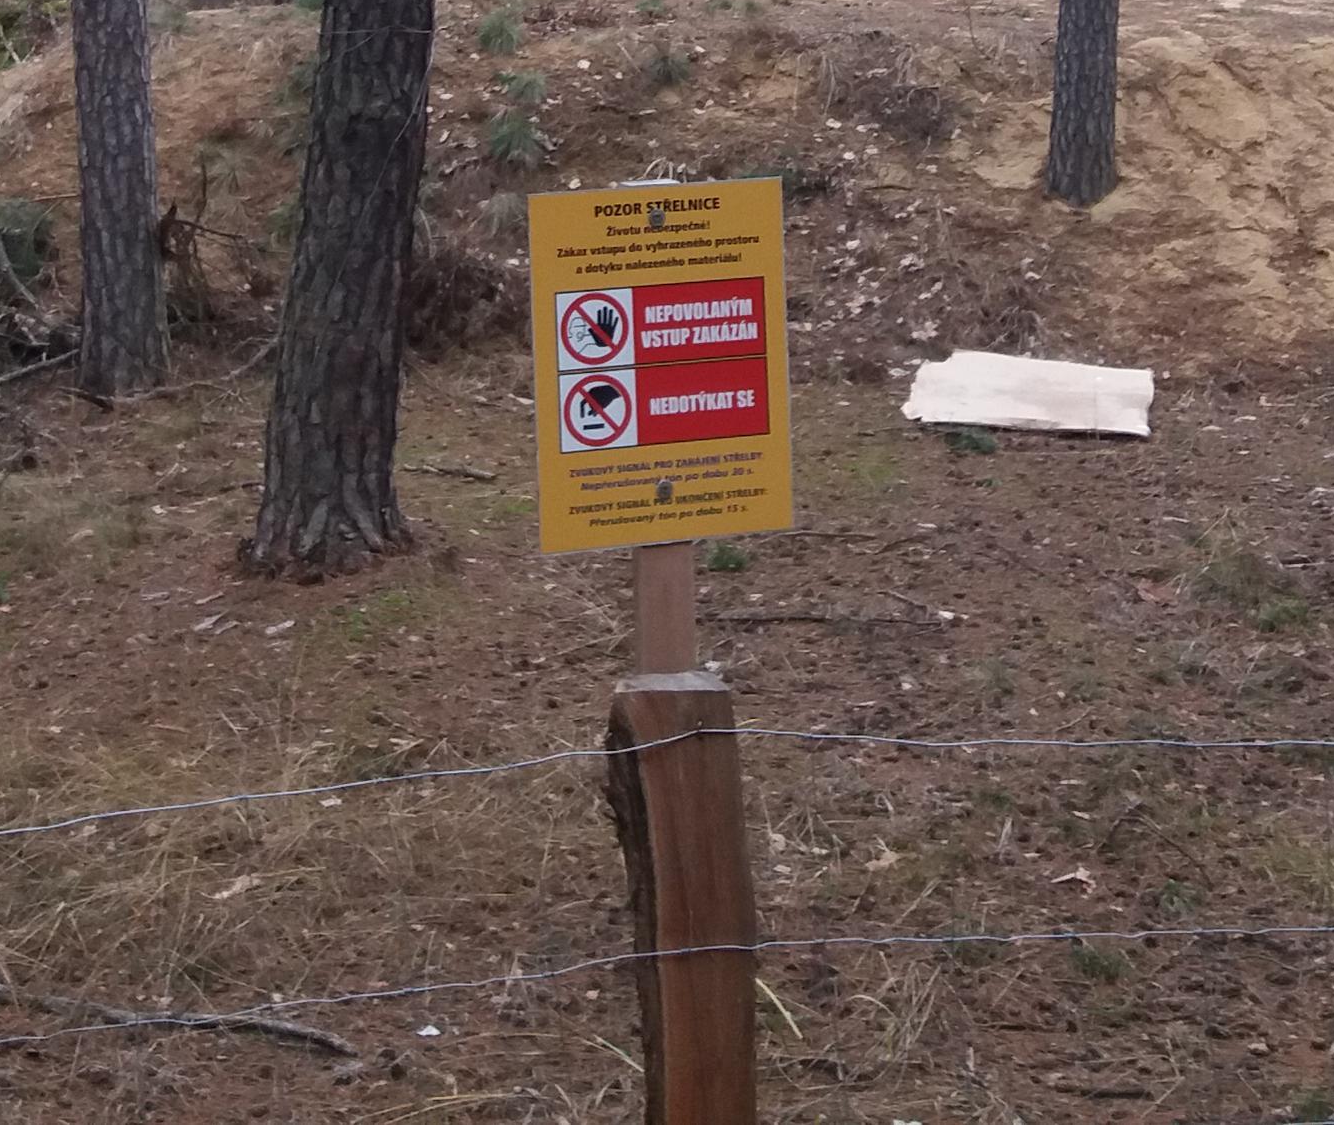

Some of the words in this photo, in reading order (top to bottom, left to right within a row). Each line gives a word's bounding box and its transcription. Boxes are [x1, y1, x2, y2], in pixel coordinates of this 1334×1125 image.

[594, 202, 642, 217] POZOR
[646, 197, 721, 215] STŘELNICE
[590, 246, 626, 260] vstupu
[629, 242, 643, 254] do
[715, 234, 760, 249] prostoru
[585, 261, 623, 275] dotyku
[645, 298, 753, 324] NEPOVOLANÝM
[641, 328, 690, 349] VSTUP
[692, 322, 758, 345] ZAKÁZÁN
[649, 391, 735, 416] NEDOTÝKAT
[737, 389, 756, 407] SE
